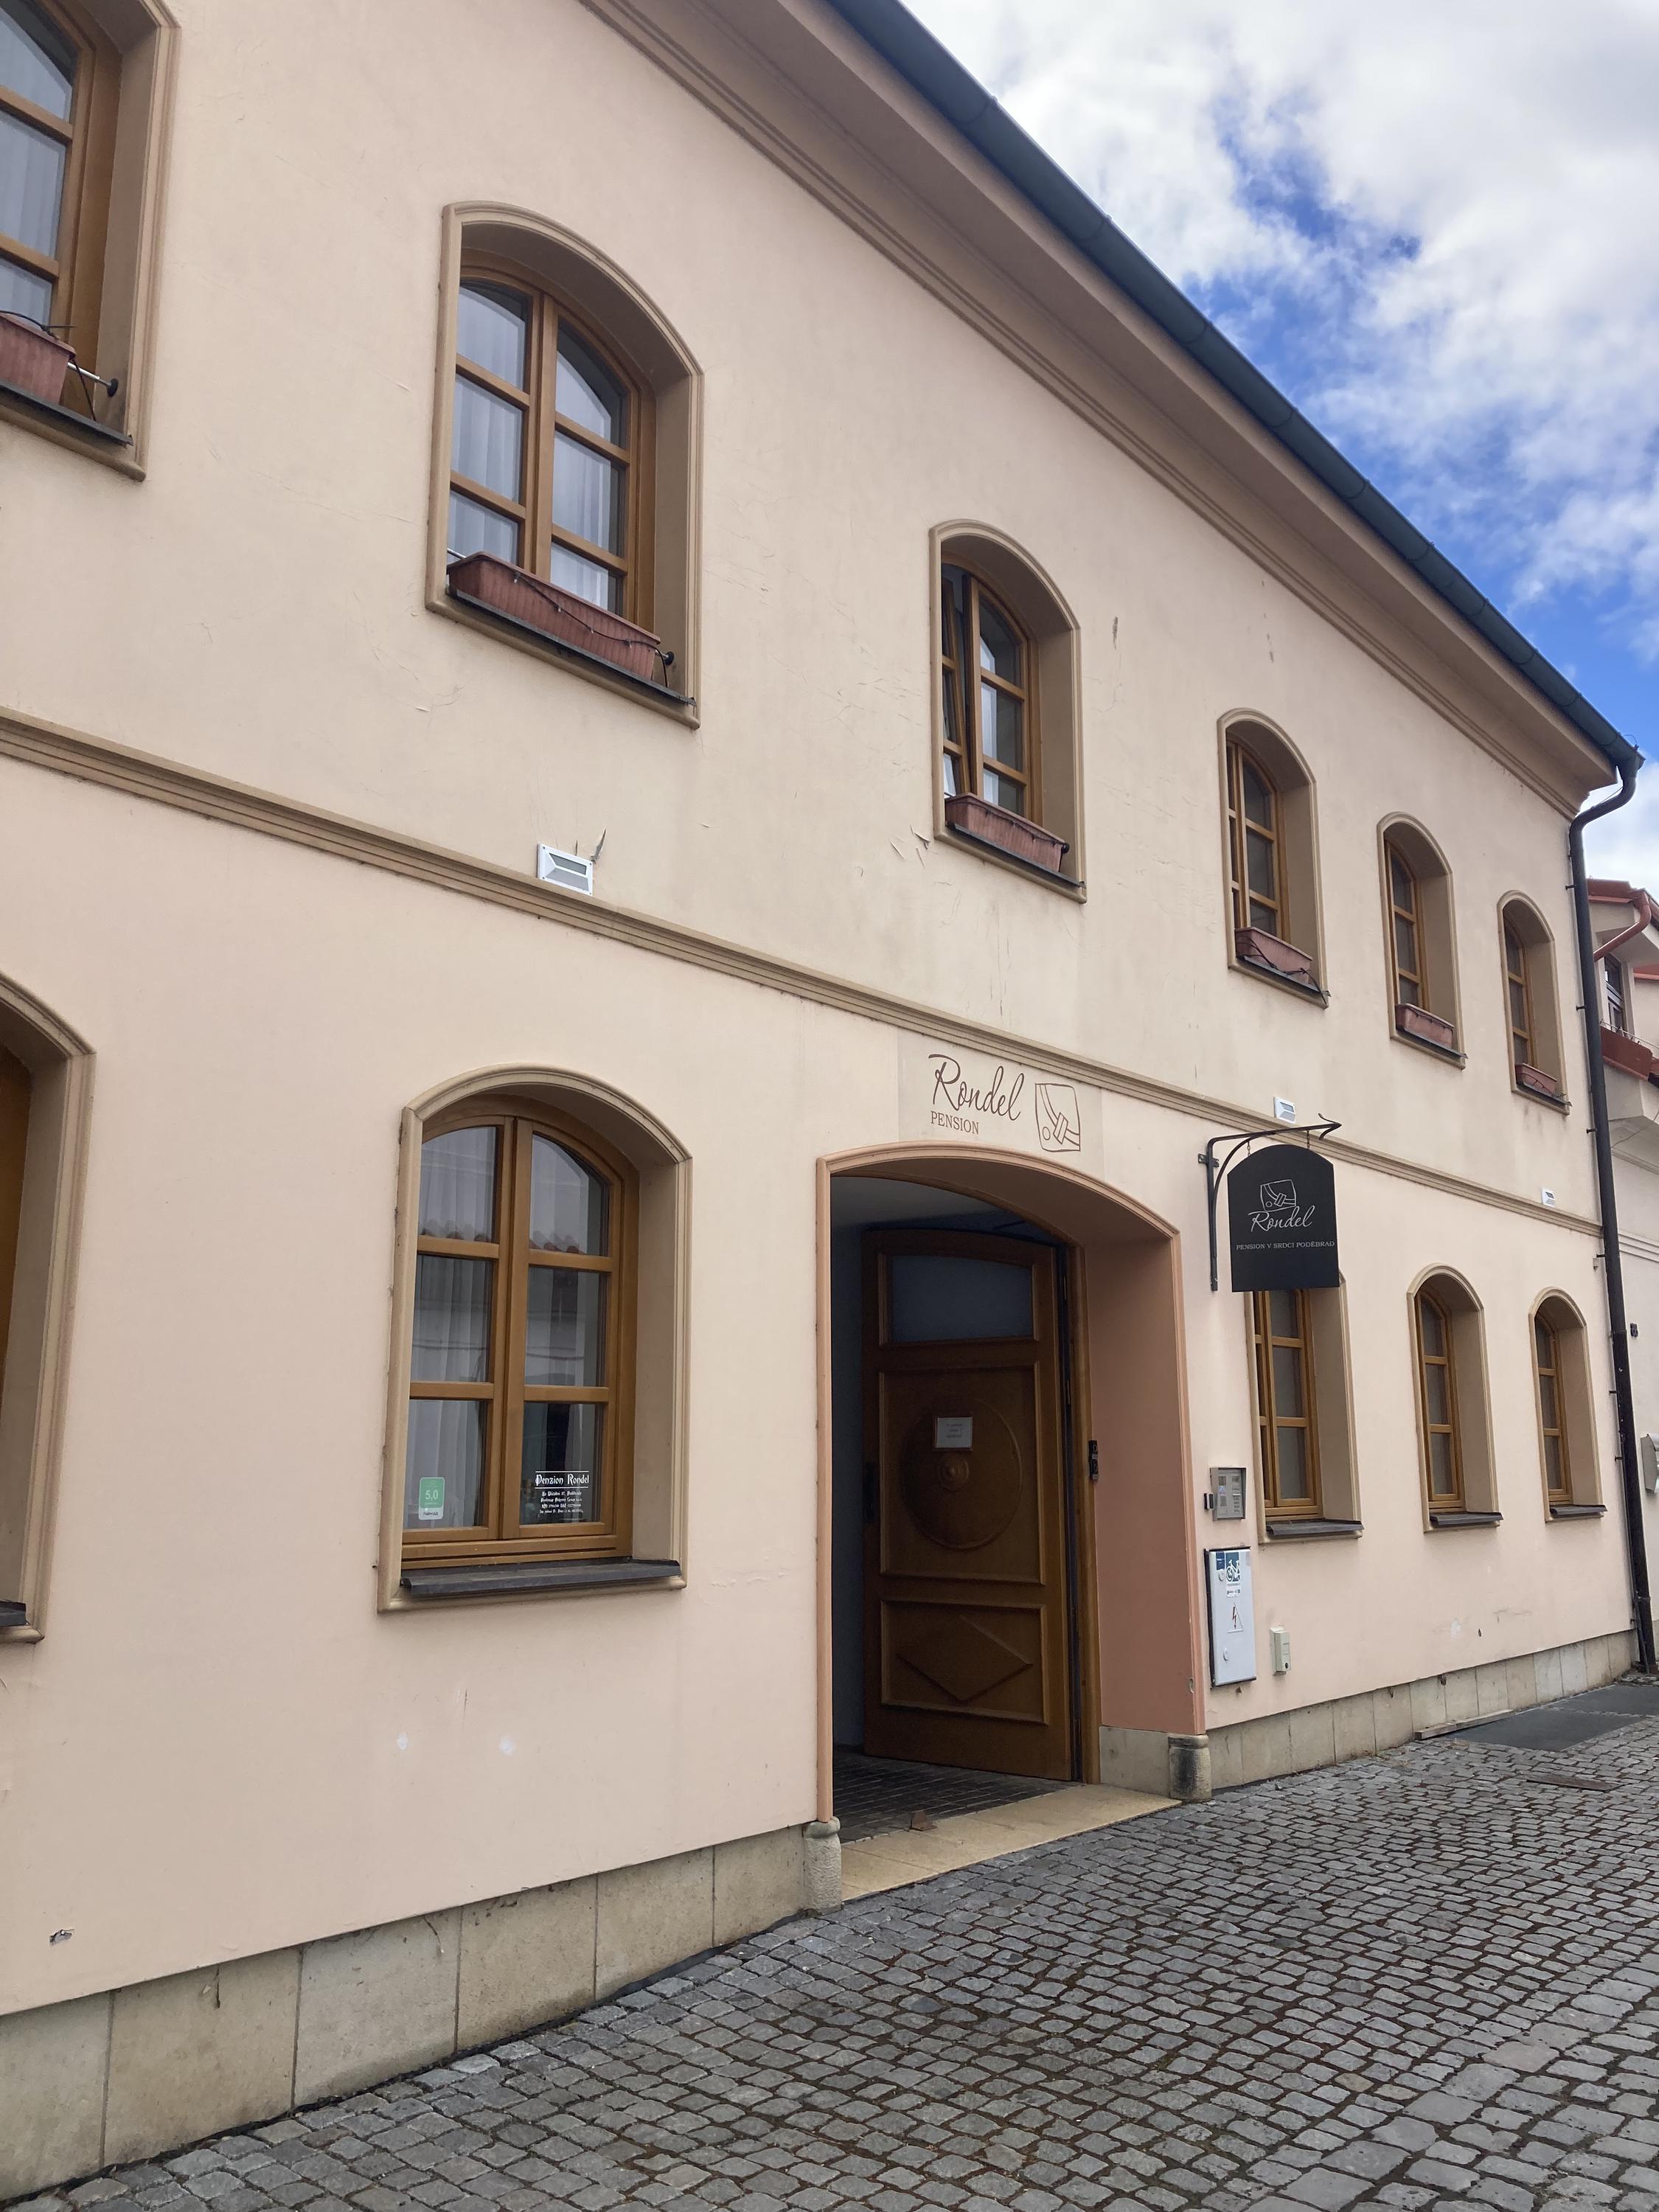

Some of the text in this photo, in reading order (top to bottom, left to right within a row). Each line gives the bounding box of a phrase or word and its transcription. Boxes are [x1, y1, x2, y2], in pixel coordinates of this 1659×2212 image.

[928, 1054, 1025, 1121] Rondel
[931, 1110, 979, 1135] PENSION
[1248, 1205, 1315, 1232] Rondel
[535, 1473, 589, 1486] Penzion Rondel
